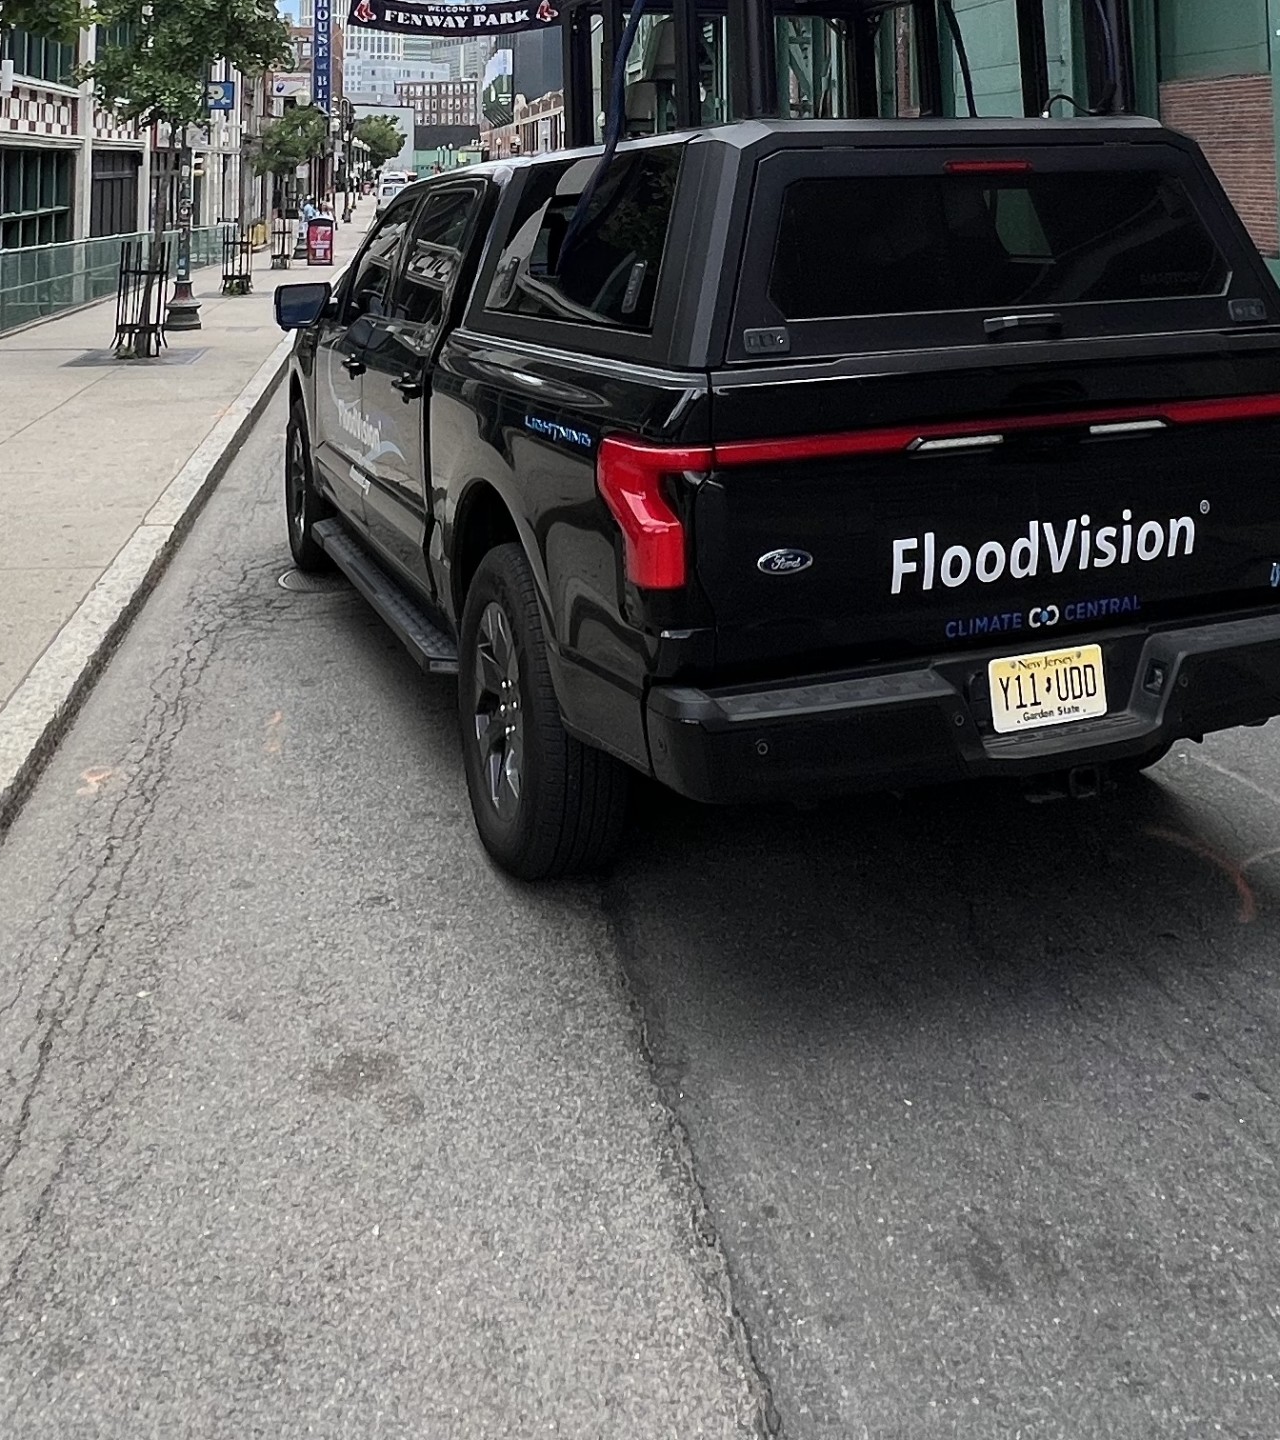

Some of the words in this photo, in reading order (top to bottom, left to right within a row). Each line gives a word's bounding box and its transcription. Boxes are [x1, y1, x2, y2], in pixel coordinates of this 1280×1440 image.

[427, 4, 471, 13] WELCOME
[384, 9, 469, 28] FENWAY
[473, 9, 530, 27] PARK
[524, 415, 592, 448] LIGHTNING
[771, 554, 801, 570] Ford
[945, 612, 1023, 638] CLIMATE
[1064, 595, 1141, 621] CENTRAL
[1017, 660, 1041, 671] New
[1043, 656, 1074, 670] Jersey
[1023, 710, 1055, 721] Garden
[1057, 705, 1080, 716] State
